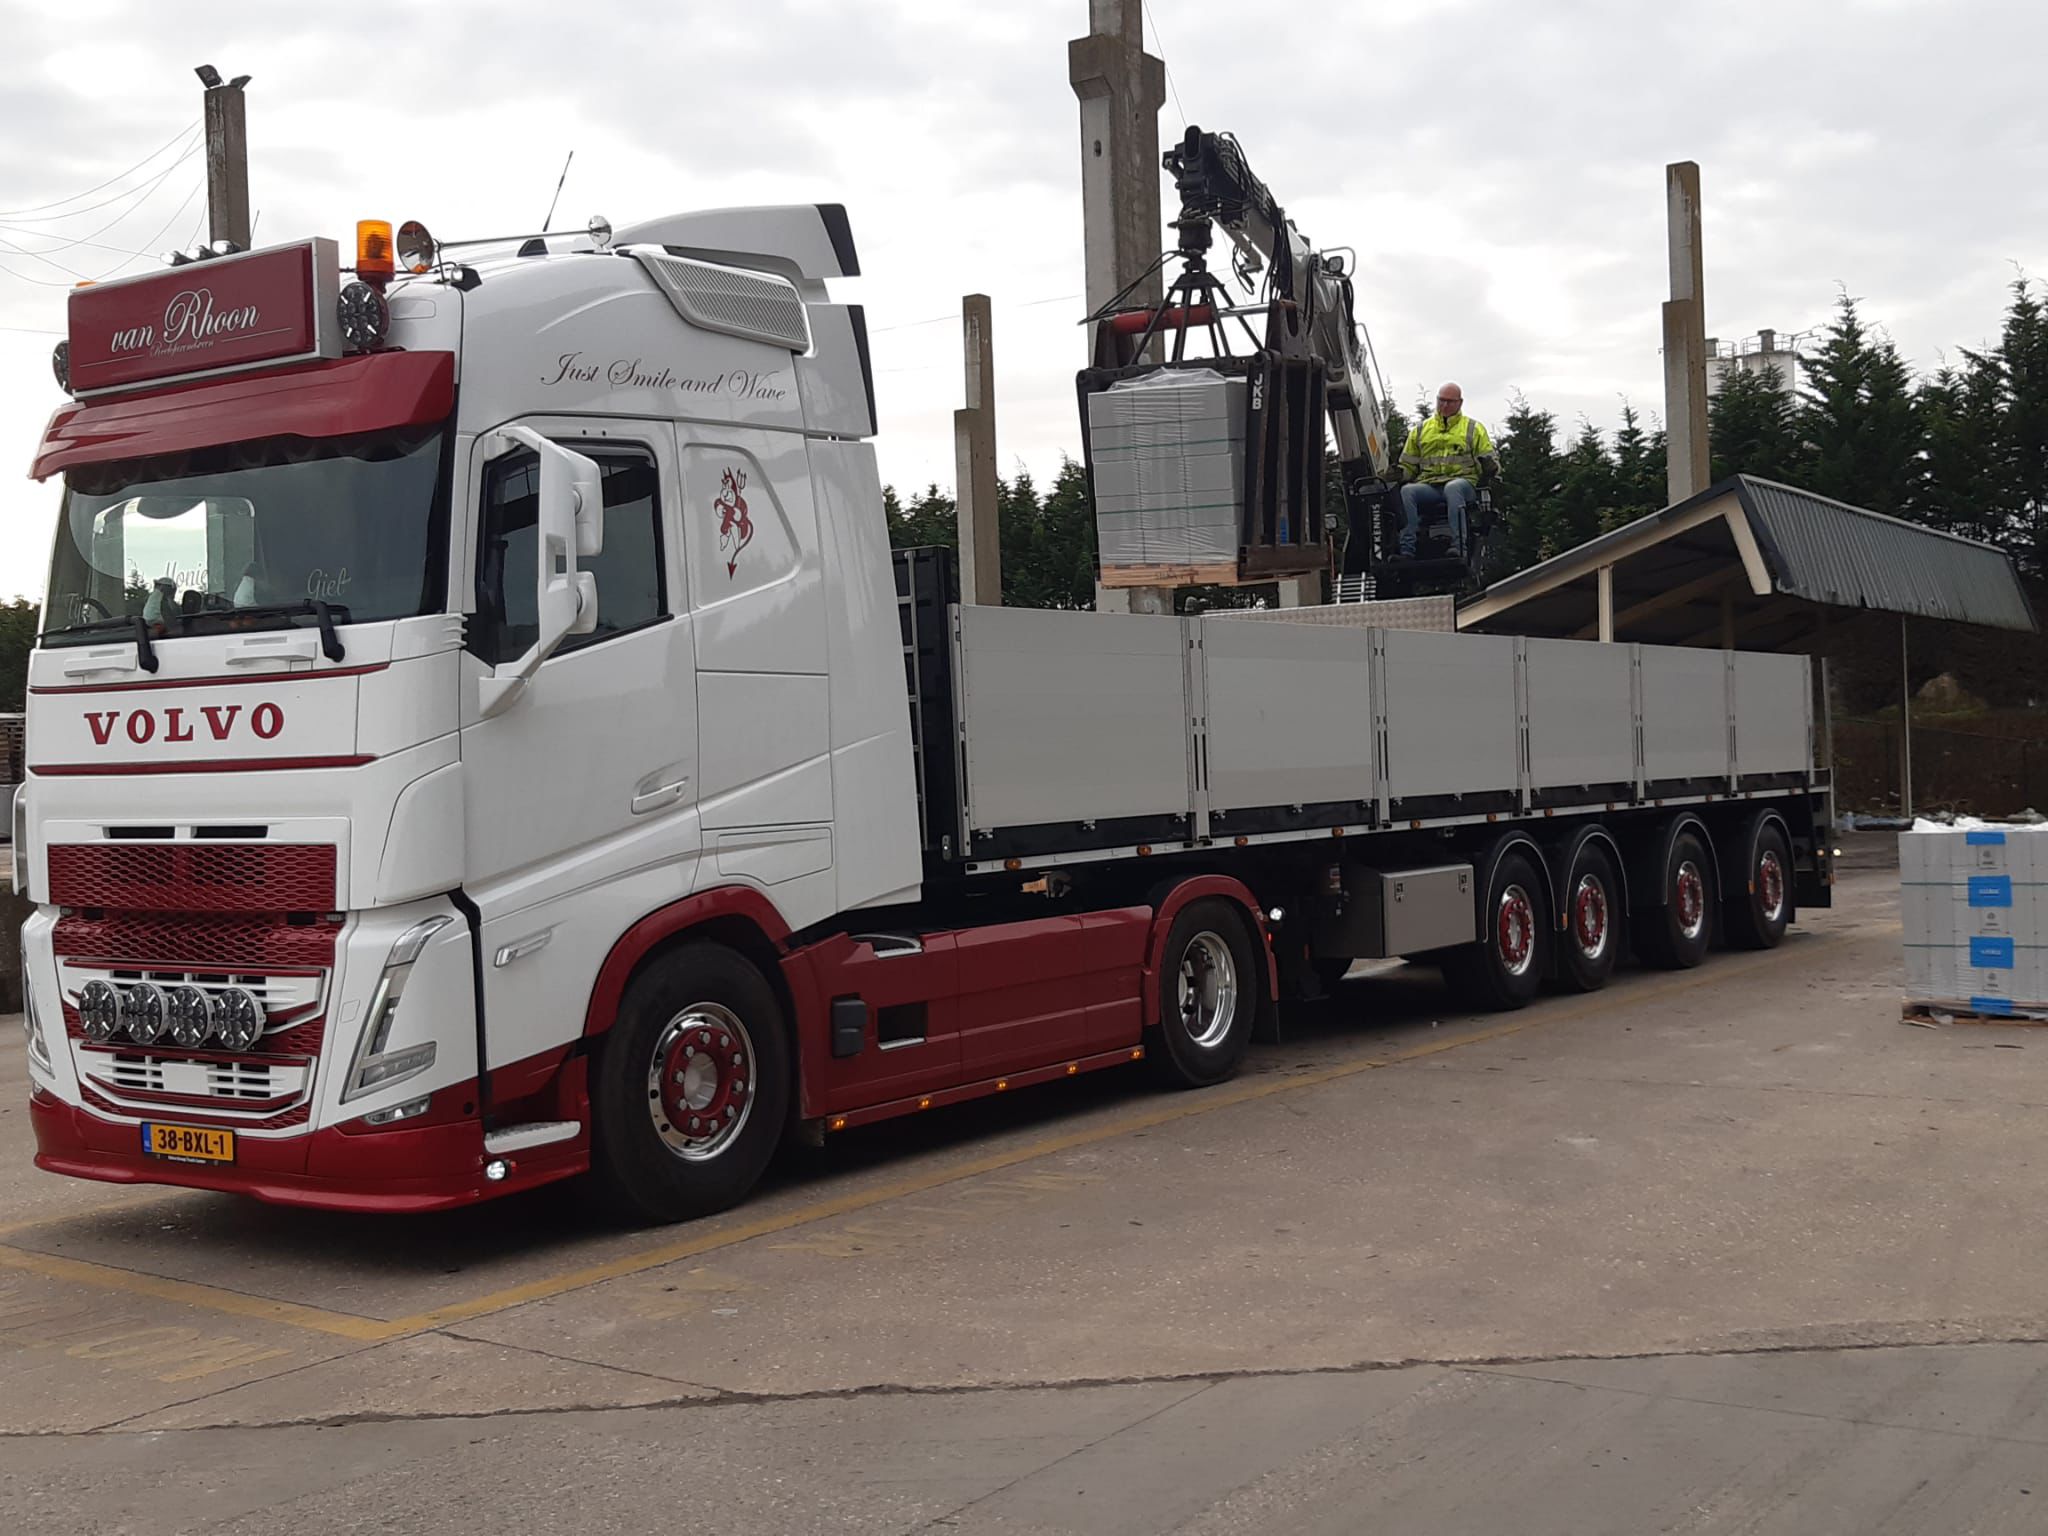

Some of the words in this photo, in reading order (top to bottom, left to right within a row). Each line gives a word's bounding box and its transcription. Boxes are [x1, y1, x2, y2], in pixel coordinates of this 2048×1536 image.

[111, 325, 155, 352] van
[163, 288, 260, 343] Rhoon
[540, 351, 599, 385] Just
[607, 358, 677, 390] Smile
[680, 373, 724, 394] and
[728, 370, 786, 400] Wave
[1252, 373, 1264, 410] JKB
[1371, 503, 1382, 543] KENNIS
[83, 702, 284, 745] VOLVO
[157, 1128, 225, 1155] 38-BXL-1
